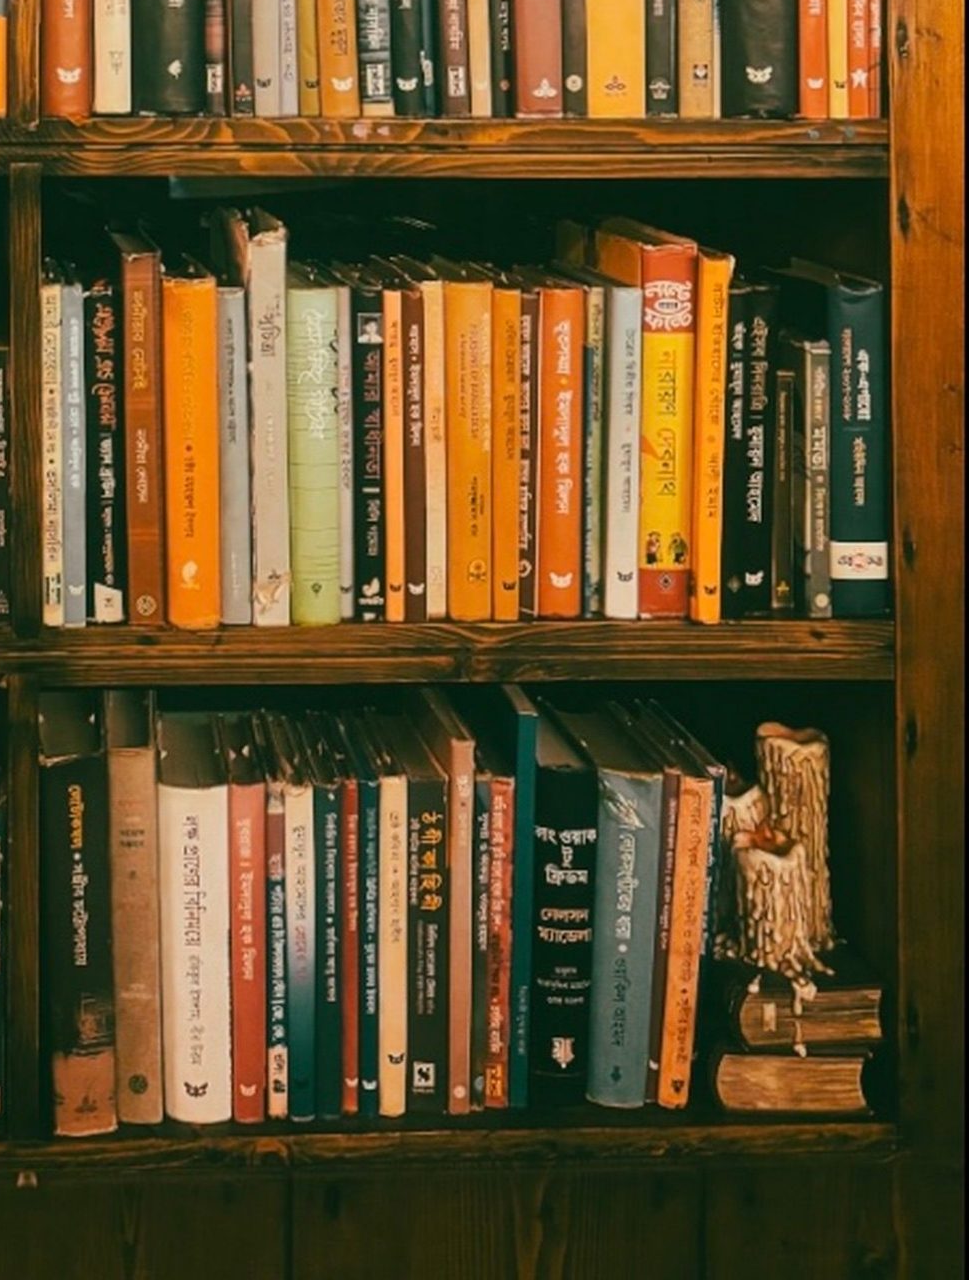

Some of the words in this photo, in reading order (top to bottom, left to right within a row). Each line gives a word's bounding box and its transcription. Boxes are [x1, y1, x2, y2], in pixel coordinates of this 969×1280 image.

[657, 350, 677, 417] নারায়ণ
[551, 390, 572, 447] ইমদাদুল
[556, 452, 569, 473] হক
[656, 428, 678, 496] দেবনাথ
[554, 478, 573, 514] মিলন
